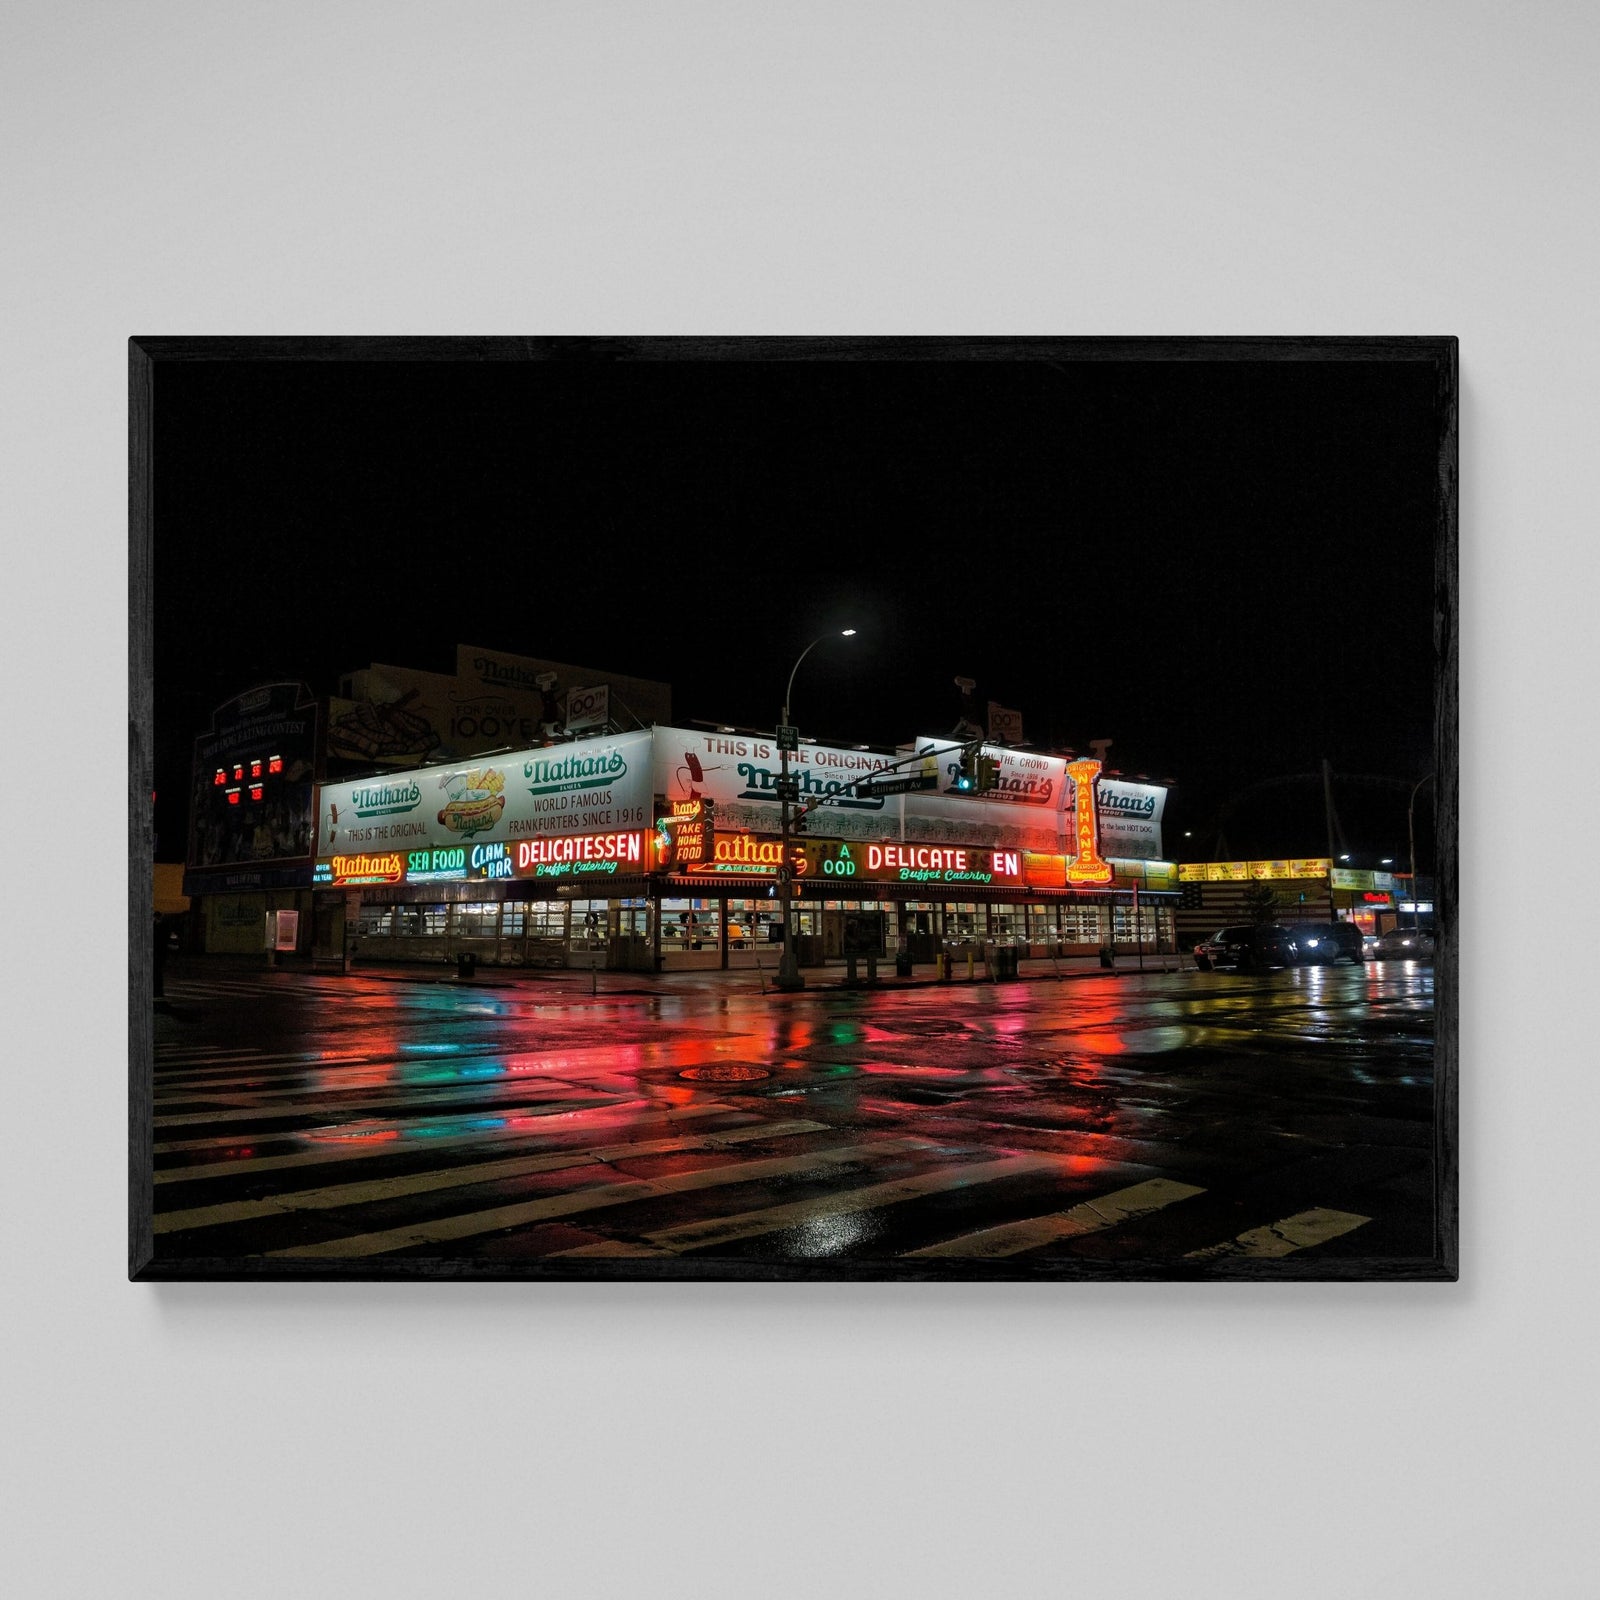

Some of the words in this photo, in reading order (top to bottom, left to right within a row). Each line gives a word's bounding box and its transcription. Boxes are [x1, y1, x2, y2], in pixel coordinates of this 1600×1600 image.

[456, 705, 481, 715] FOR
[485, 705, 517, 715] OVER
[703, 738, 748, 757] THIS
[753, 743, 770, 759] IS
[814, 750, 894, 775] ORIGINAL
[1000, 754, 1016, 766] THE
[1019, 757, 1049, 771] CROWD
[352, 778, 420, 809] Nathan's
[871, 782, 906, 794] Stillwell
[534, 797, 568, 813] WORLD
[571, 790, 612, 808] FAMOUS
[1098, 788, 1156, 812] than's
[453, 813, 494, 831] Nathan's
[508, 814, 580, 833] FRANKFURTERS
[582, 810, 611, 827] SINCE
[615, 807, 643, 824] 1916
[1077, 773, 1092, 862] NATHANS
[348, 830, 364, 842] THIS
[365, 828, 372, 840] IS
[374, 826, 389, 839] THE
[390, 822, 427, 838] ORIGINAL
[676, 823, 702, 835] TAKE
[677, 834, 703, 846] HOME
[408, 851, 430, 871] SEA
[432, 848, 465, 870] FOOD
[471, 842, 504, 868] CLAM
[518, 833, 641, 868] DELICATESSEN
[676, 846, 702, 860] FOOD
[315, 864, 330, 872] OPEN
[332, 854, 401, 877] Nathan's
[488, 857, 513, 878] BAR
[536, 861, 571, 877] Buffet
[572, 859, 618, 875] Catering
[899, 867, 941, 882] Buffet
[944, 868, 992, 884] Catering
[313, 874, 321, 882] ALL
[321, 873, 333, 881] YEAR
